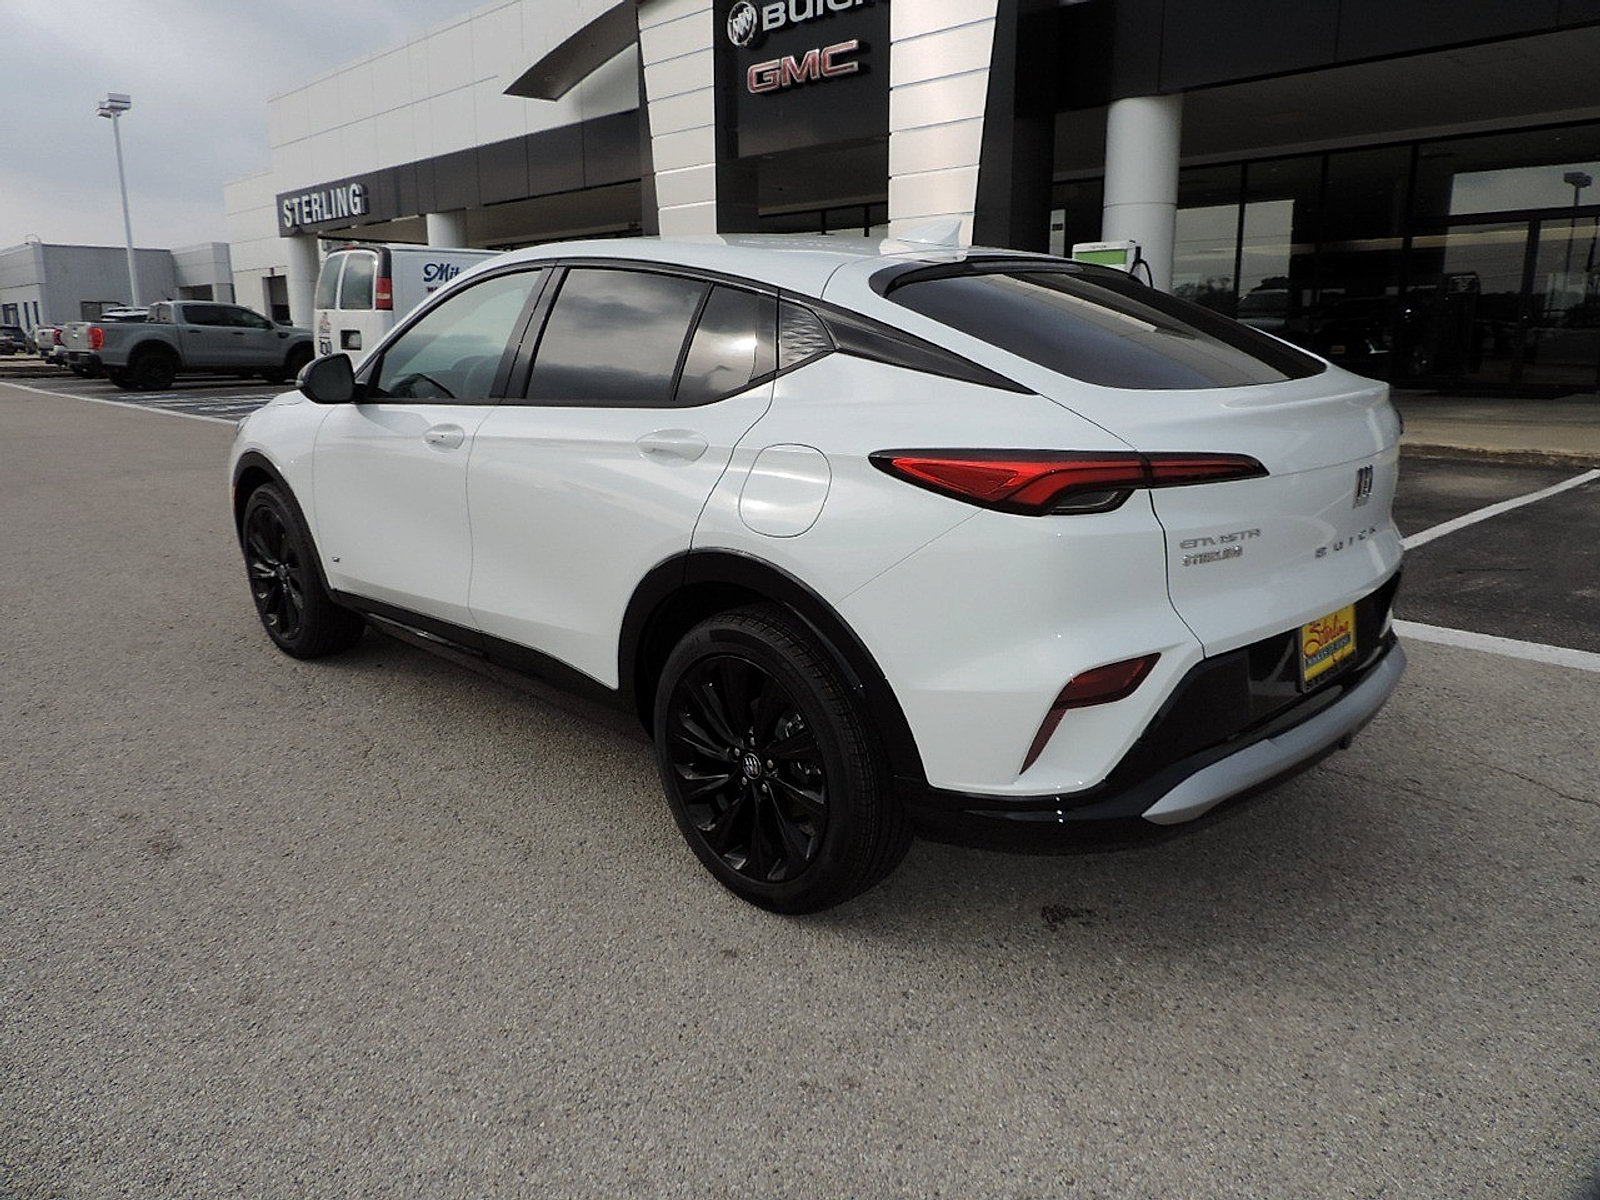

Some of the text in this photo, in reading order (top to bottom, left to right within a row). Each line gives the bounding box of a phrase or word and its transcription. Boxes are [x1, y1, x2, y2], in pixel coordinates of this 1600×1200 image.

[762, 0, 864, 31] BUI
[747, 39, 859, 93] GMC
[283, 183, 363, 228] STERLING
